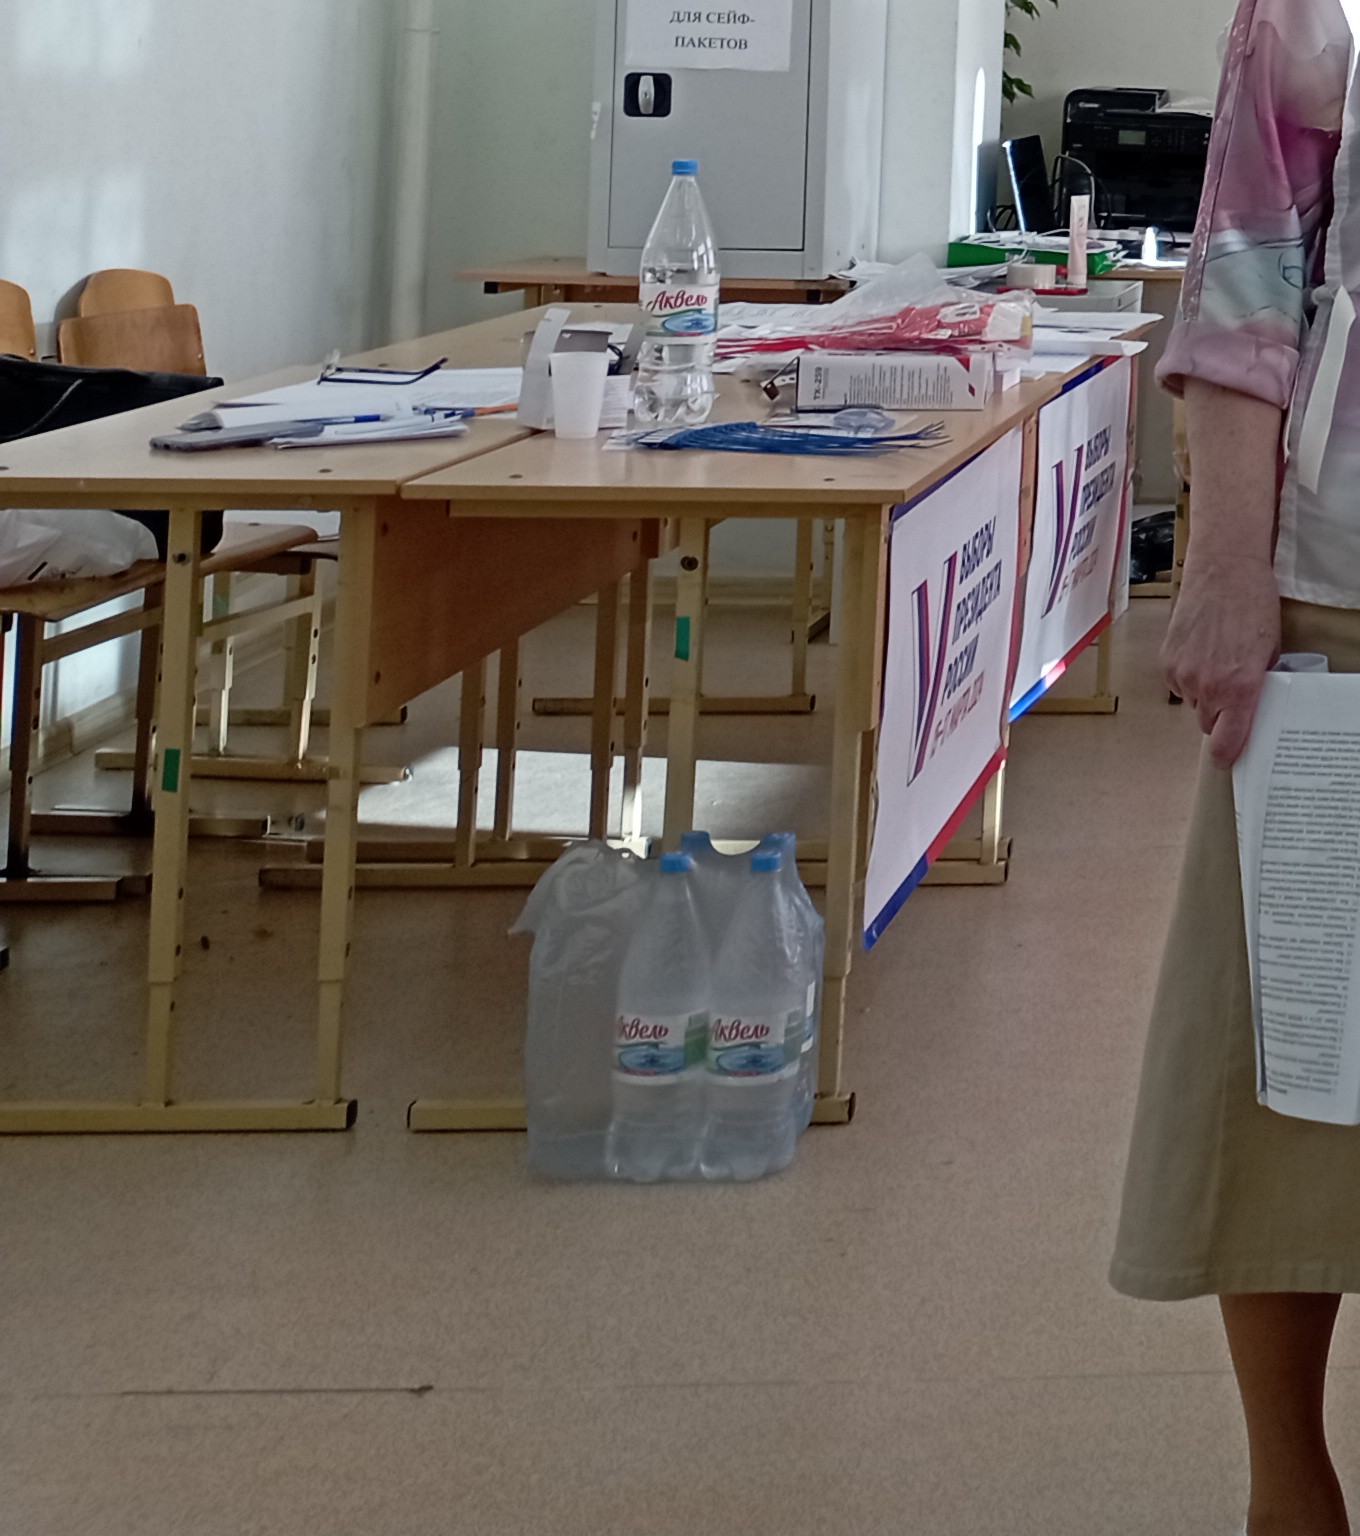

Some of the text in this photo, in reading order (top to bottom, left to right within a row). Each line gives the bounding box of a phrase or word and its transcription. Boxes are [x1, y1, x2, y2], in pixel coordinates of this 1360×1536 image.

[669, 10, 755, 24] ДЛЯ СЕЙФ-
[674, 35, 748, 50] ПАКЕТОВ
[959, 515, 997, 586] ВЫБОРЫ
[940, 633, 980, 707] РОССИИ
